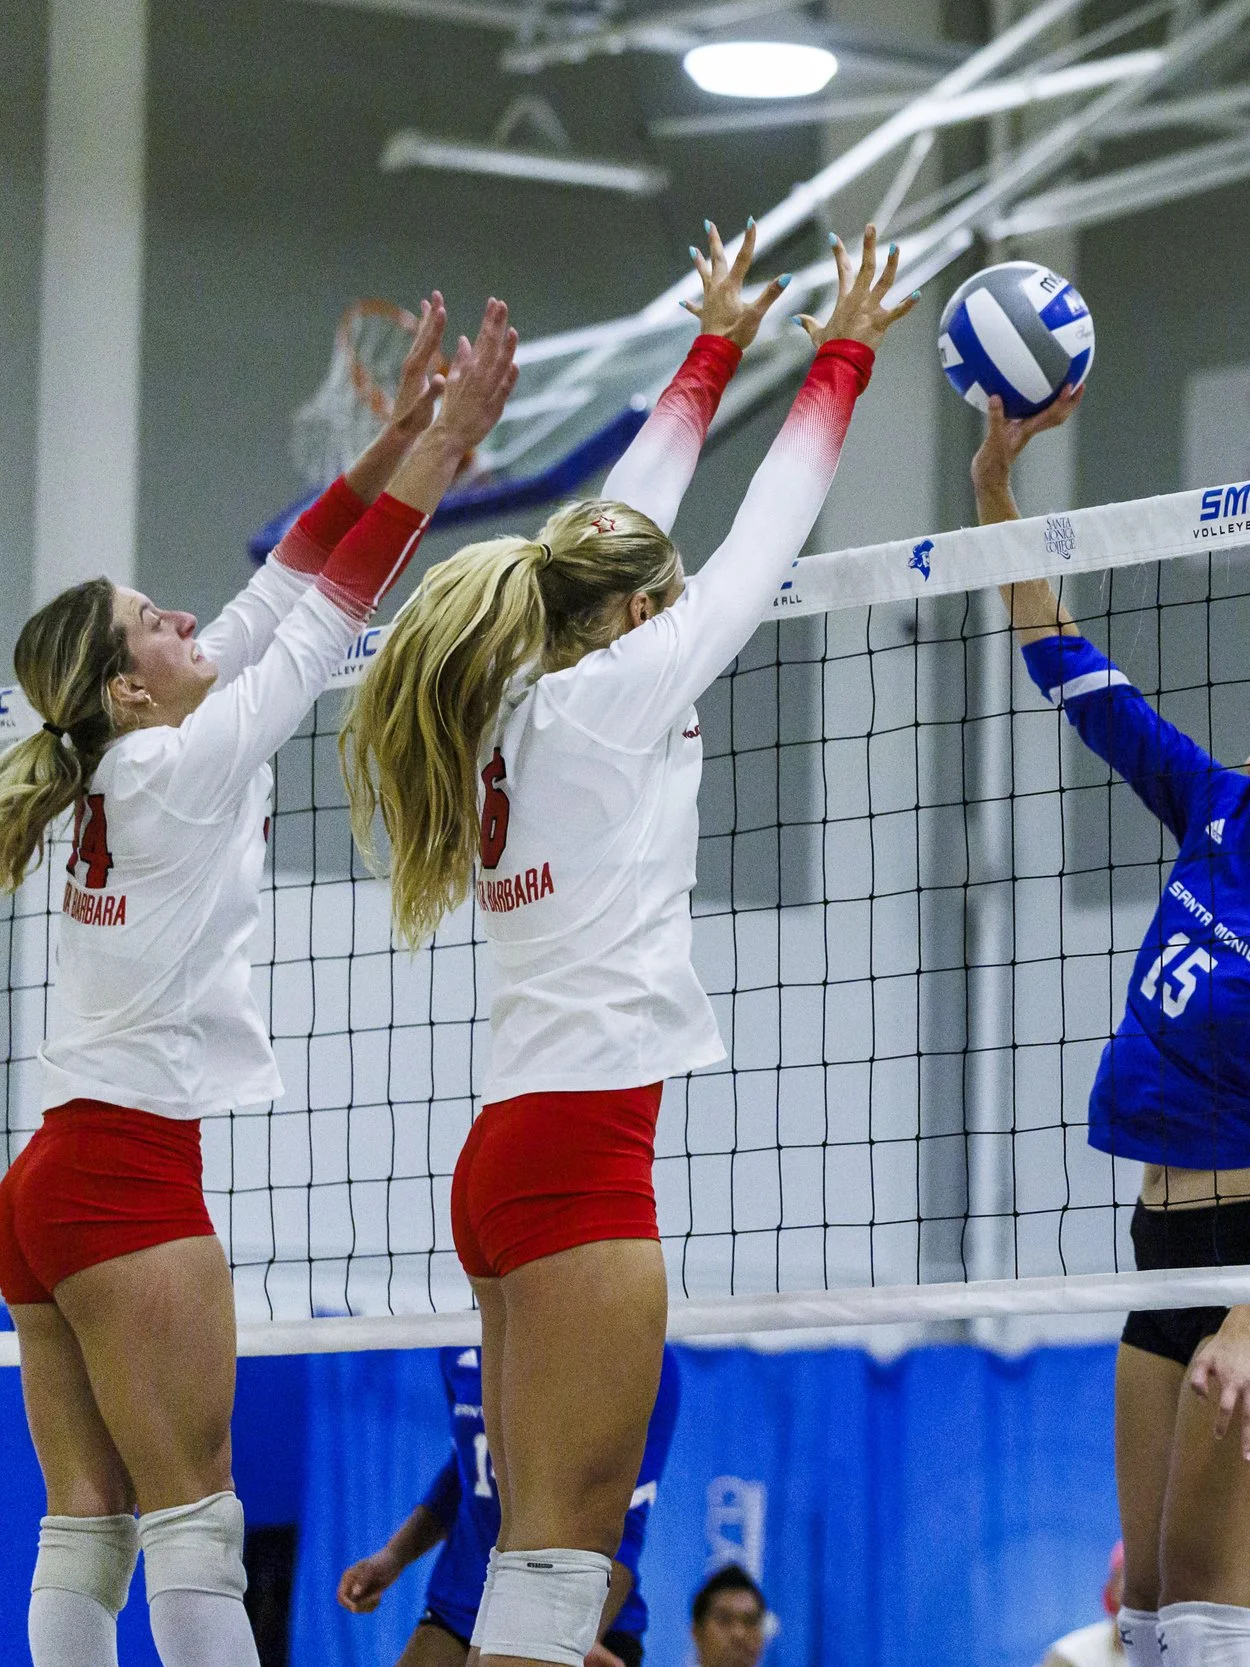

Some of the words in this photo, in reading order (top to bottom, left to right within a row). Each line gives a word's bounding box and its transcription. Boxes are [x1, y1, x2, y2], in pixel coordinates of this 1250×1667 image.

[71, 888, 126, 926] BARBARA
[487, 862, 554, 912] BARBARA
[1168, 881, 1214, 926] SANTA
[1140, 932, 1218, 1019] 15
